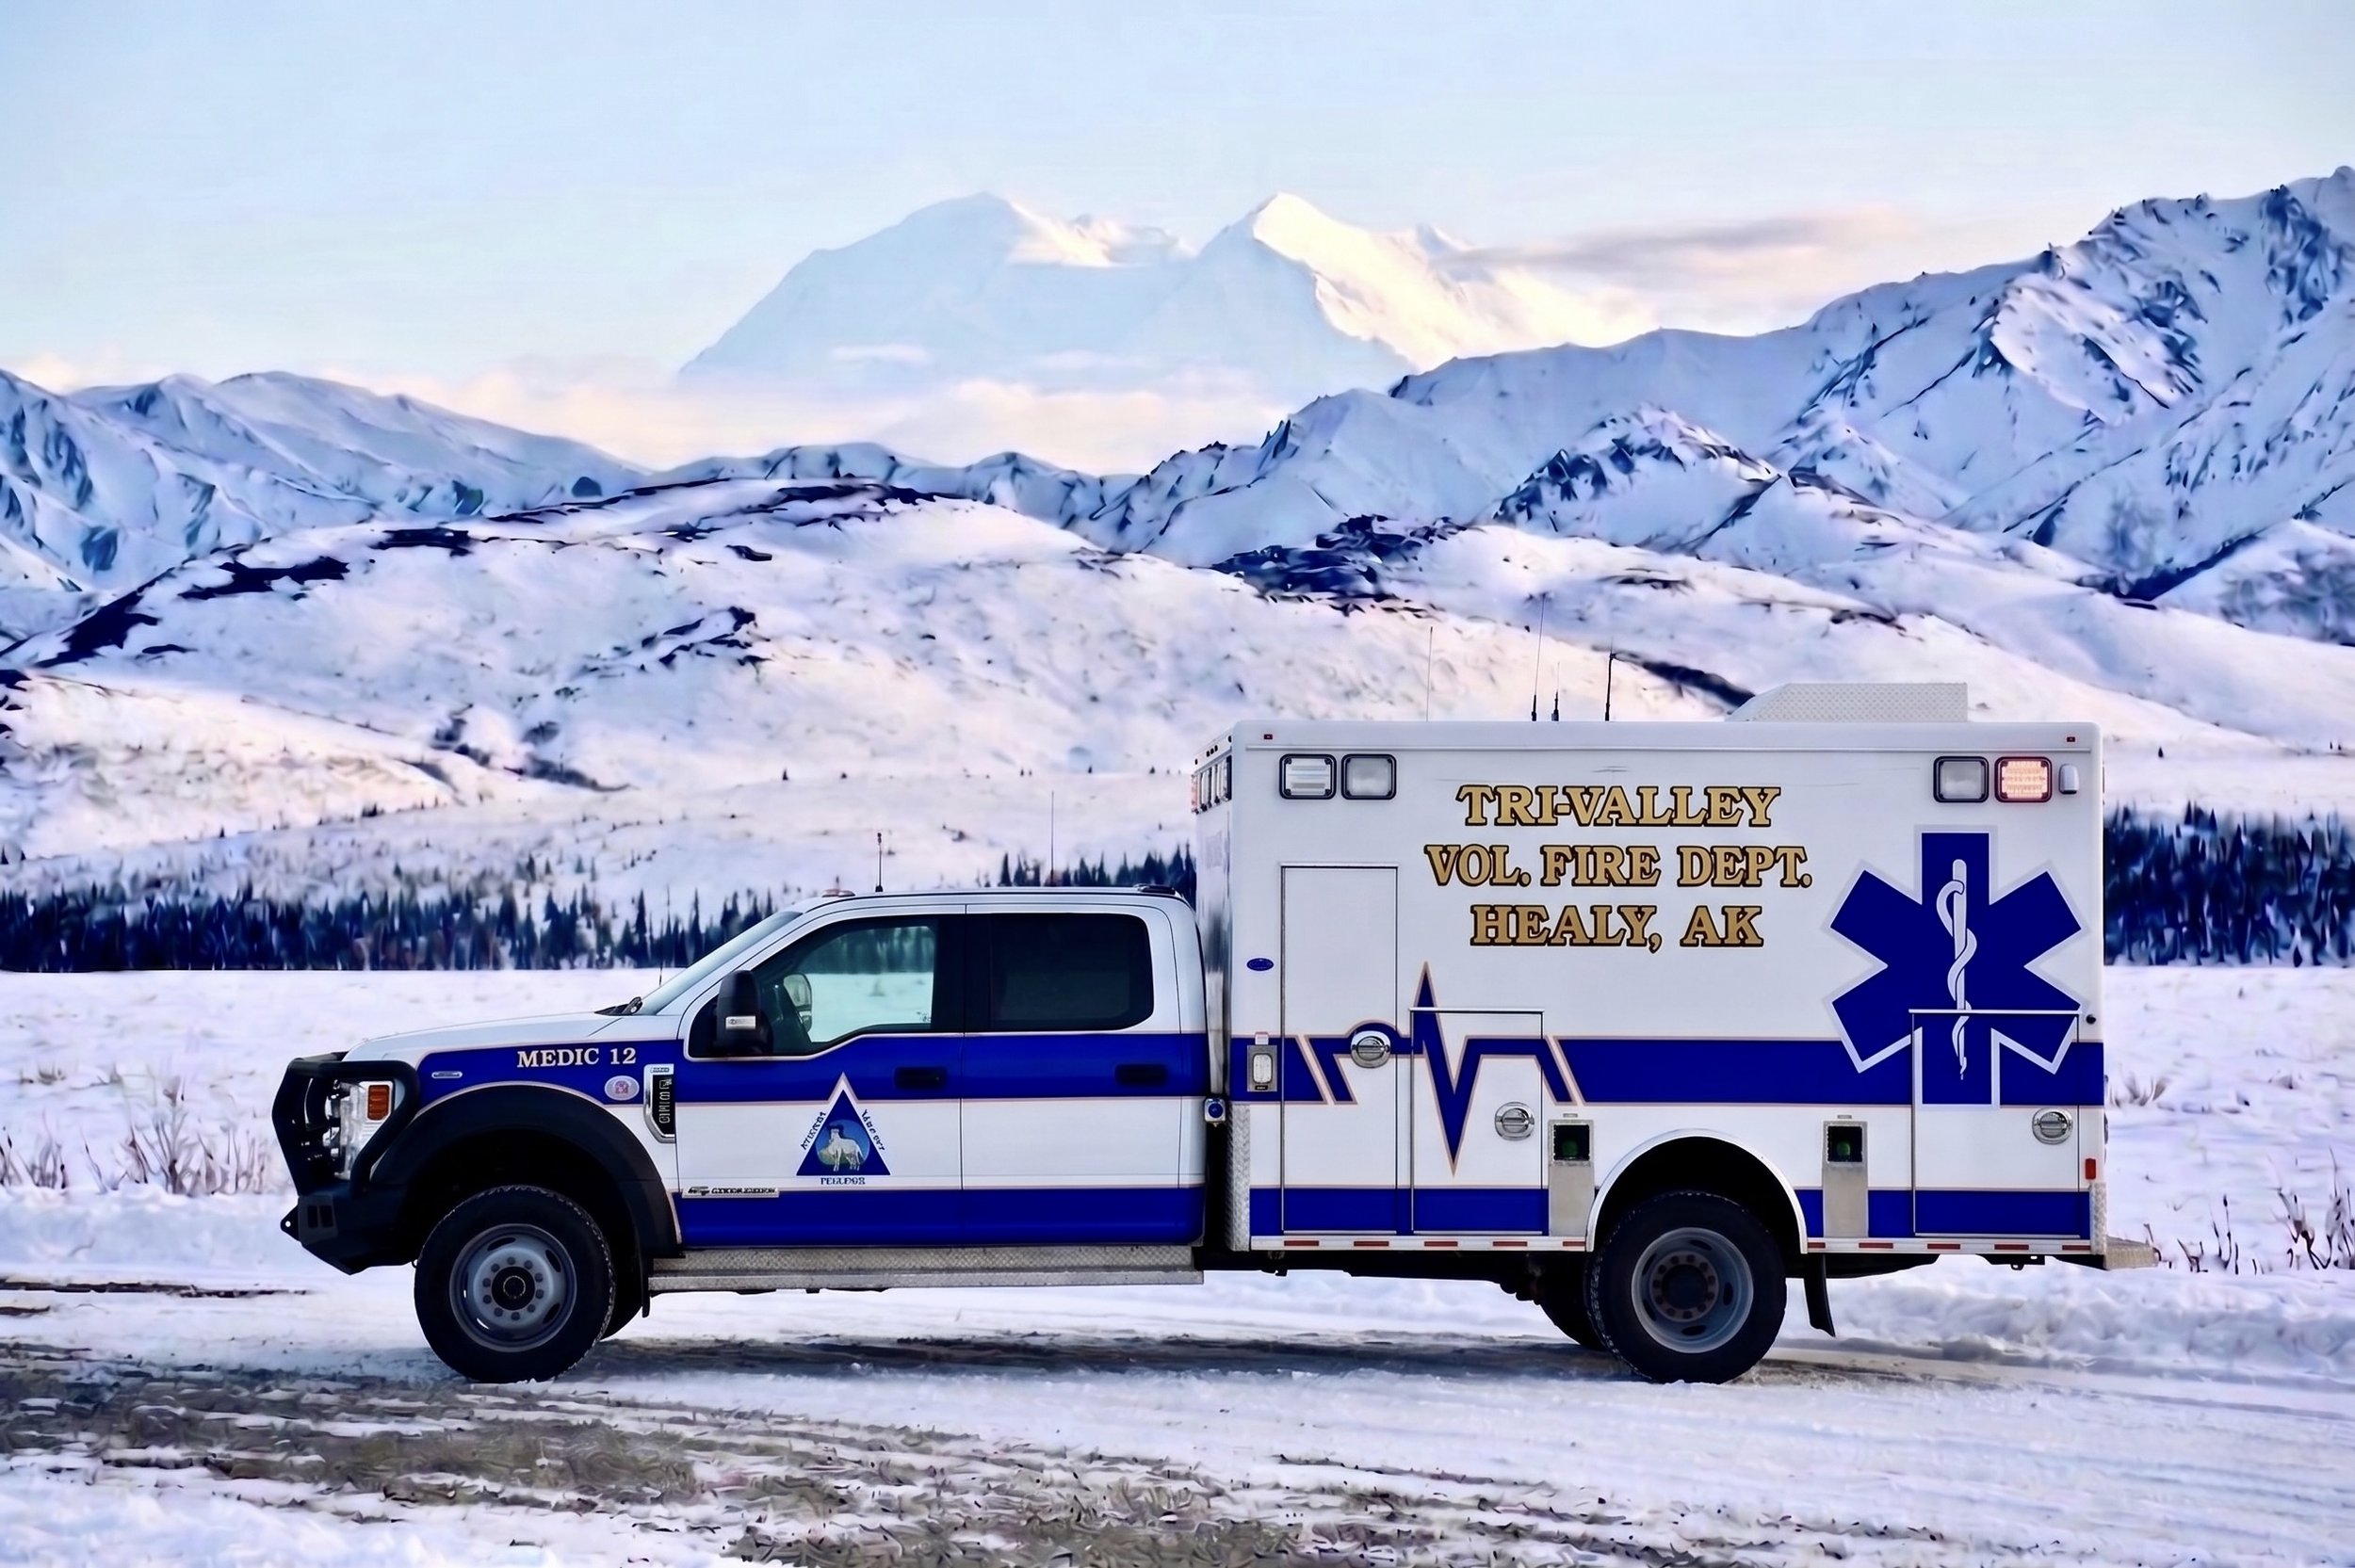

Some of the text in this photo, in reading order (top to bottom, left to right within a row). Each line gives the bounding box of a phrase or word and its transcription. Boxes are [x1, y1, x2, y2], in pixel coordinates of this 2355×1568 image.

[1455, 784, 1781, 827] TRI-VALLEY
[1423, 844, 1812, 888] VOL. FIRE DEPT.
[1470, 904, 1763, 953] HEALY, AK
[517, 1047, 637, 1068] MEDIC 12
